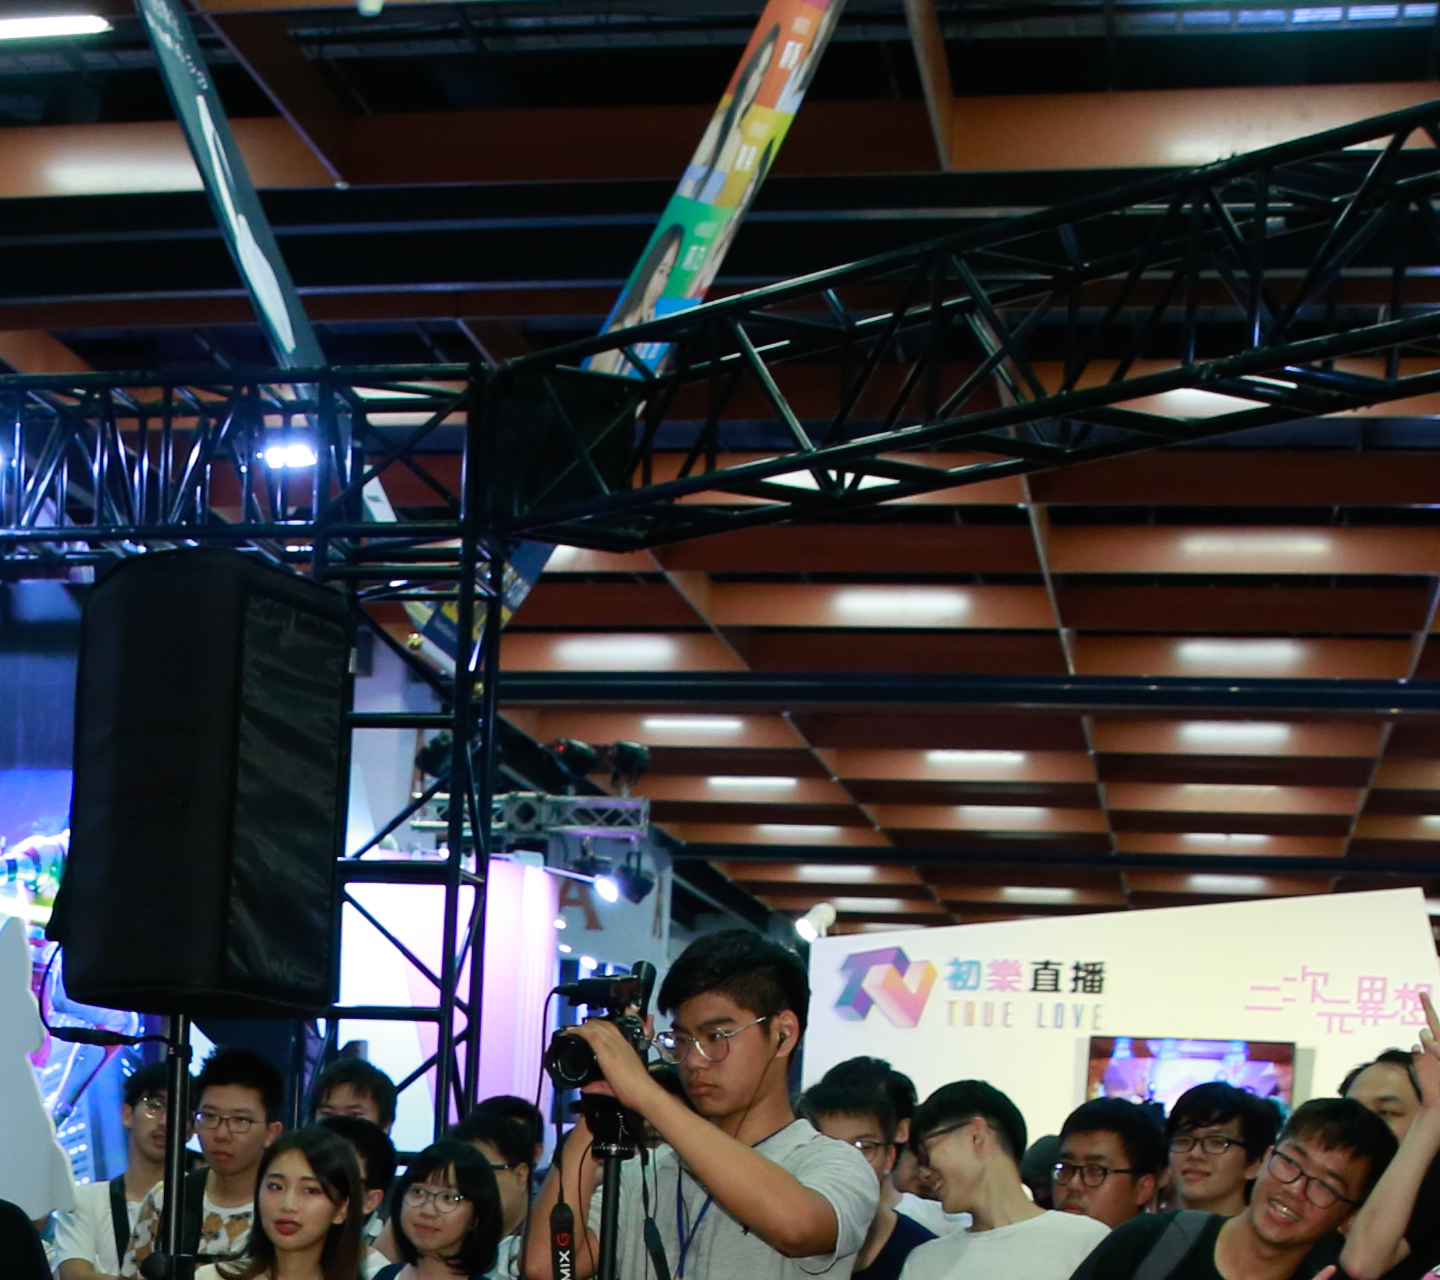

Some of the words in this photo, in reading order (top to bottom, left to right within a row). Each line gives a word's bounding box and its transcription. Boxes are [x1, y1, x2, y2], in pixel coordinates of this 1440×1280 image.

[945, 957, 1105, 994] 初樂直播
[948, 1000, 1014, 1029] TRUE
[1036, 1002, 1105, 1031] LOVE
